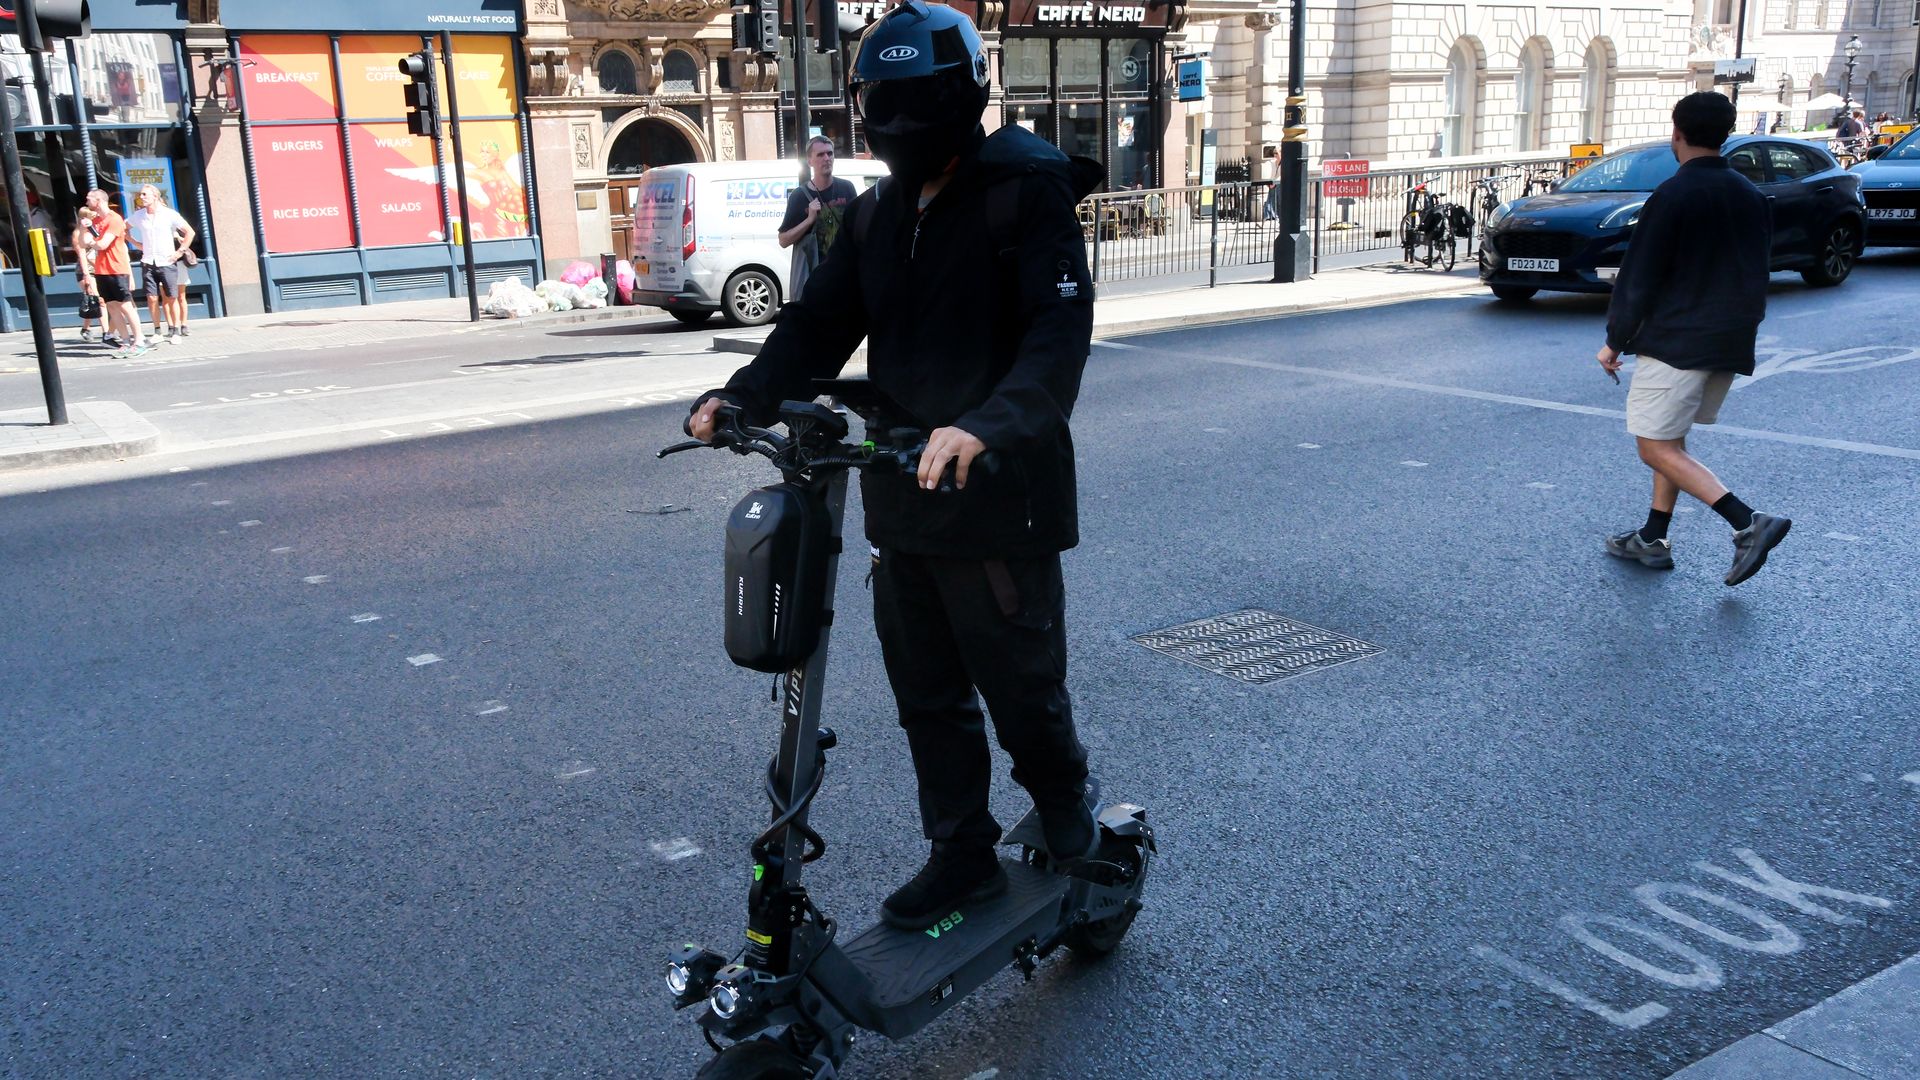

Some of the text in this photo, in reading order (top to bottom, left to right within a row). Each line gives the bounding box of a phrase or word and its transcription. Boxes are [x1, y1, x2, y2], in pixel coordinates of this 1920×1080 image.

[837, 0, 887, 19] AFFÈ
[1038, 1, 1145, 21] CAFFÈ NERO
[427, 15, 471, 23] NATURALLY
[491, 16, 515, 24] FOOD
[886, 50, 912, 58] AD
[255, 72, 320, 83] BREAKFAST
[272, 141, 323, 151] BURGERS
[375, 137, 413, 147] WRAPS
[1325, 163, 1367, 173] BUS LANE
[745, 182, 799, 200] EXCE
[1328, 185, 1363, 193] CLOSED
[273, 207, 339, 219] RICE BOXES
[381, 202, 422, 213] SALADS
[1868, 209, 1916, 217] LR75 JOJ
[1511, 259, 1555, 270] FD23 AZC
[216, 384, 351, 403] LOOK
[1471, 847, 1892, 1029] LOOK
